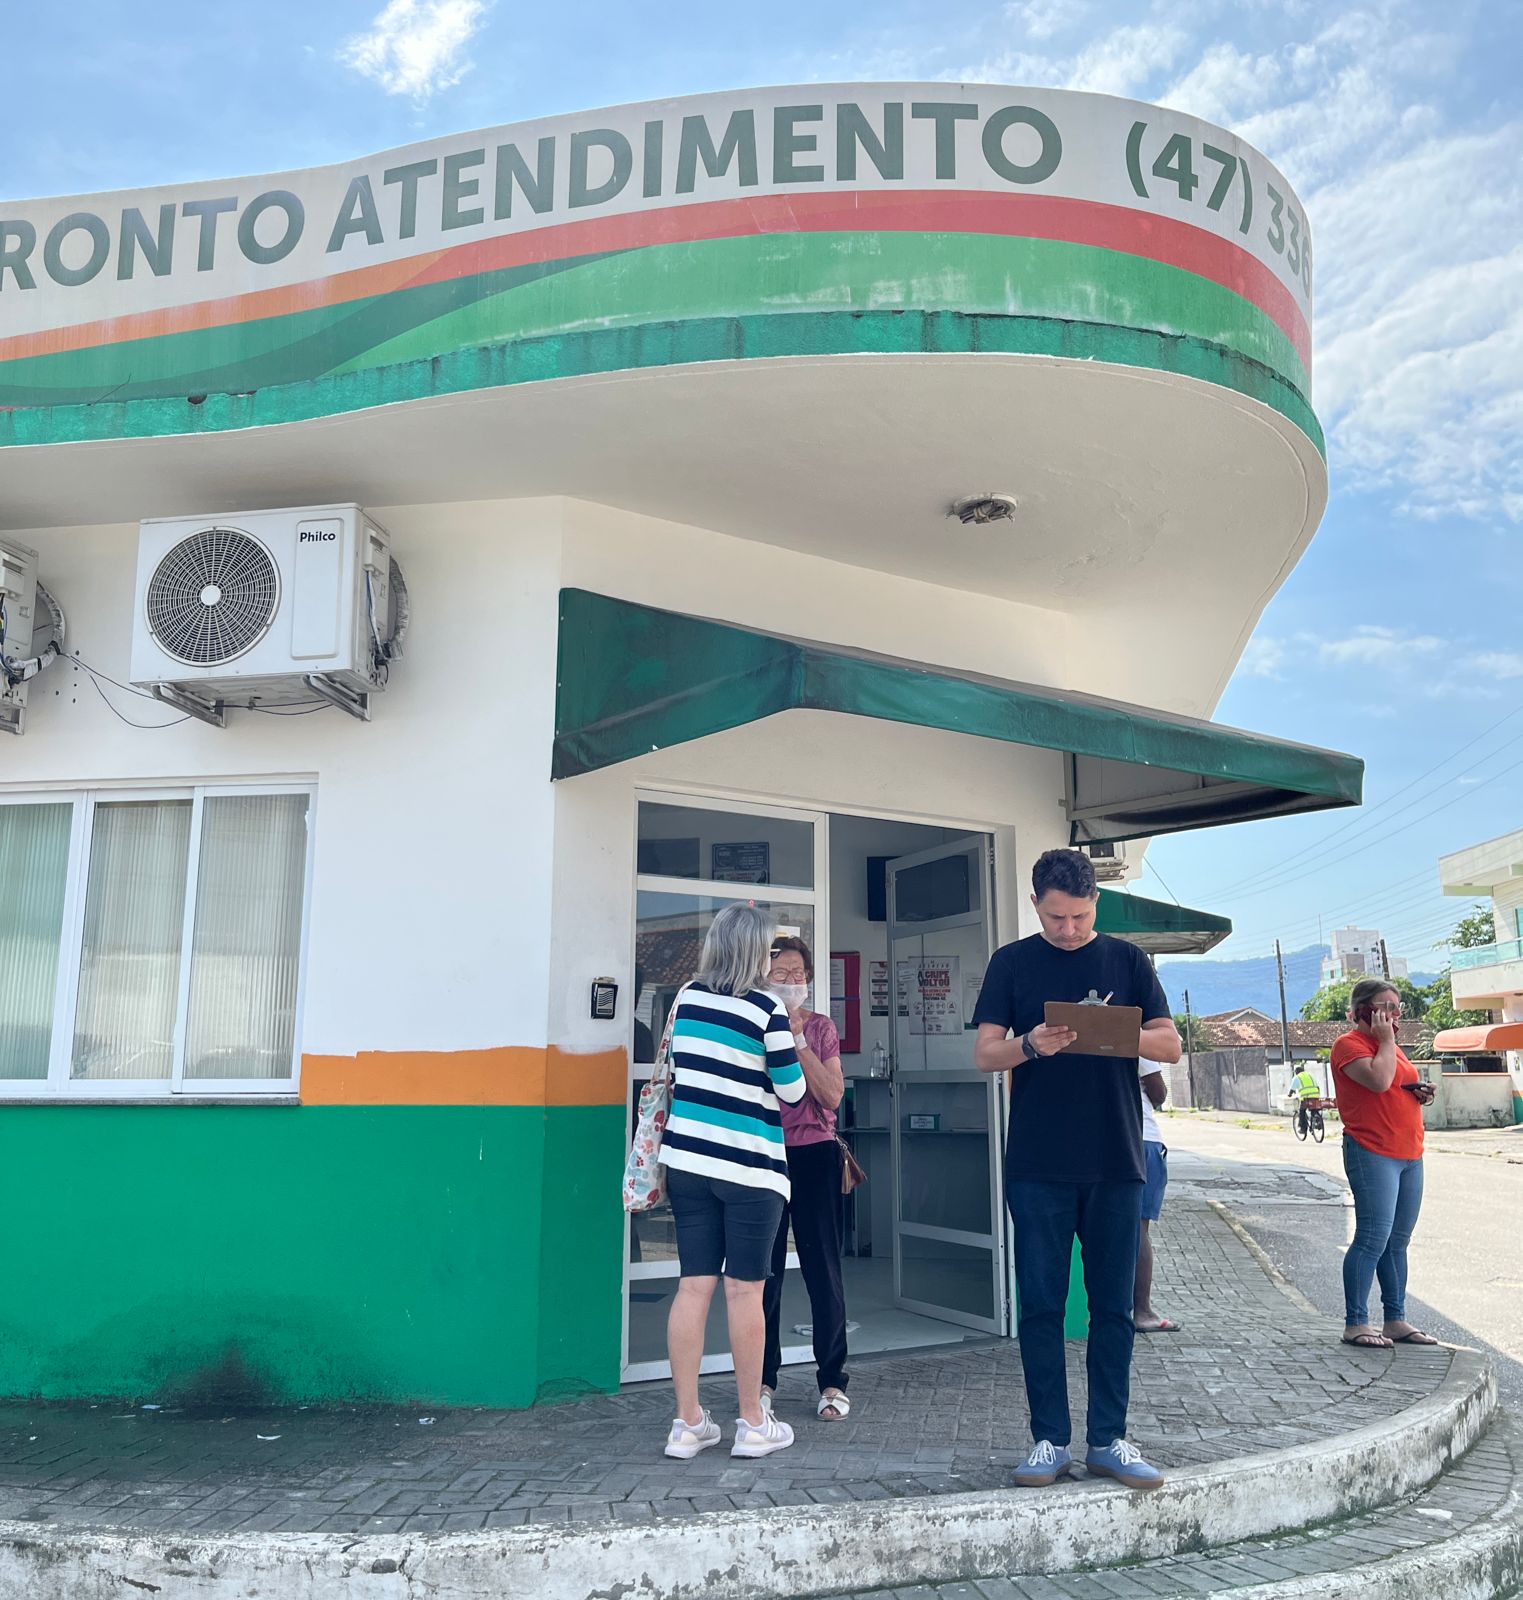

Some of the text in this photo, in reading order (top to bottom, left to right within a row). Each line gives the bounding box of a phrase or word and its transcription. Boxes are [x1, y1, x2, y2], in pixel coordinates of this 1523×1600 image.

[325, 101, 1063, 254] ATENDIMENTO
[1126, 120, 1253, 235] (47)
[299, 531, 336, 543] Philco
[918, 978, 950, 987] VOLTOU
